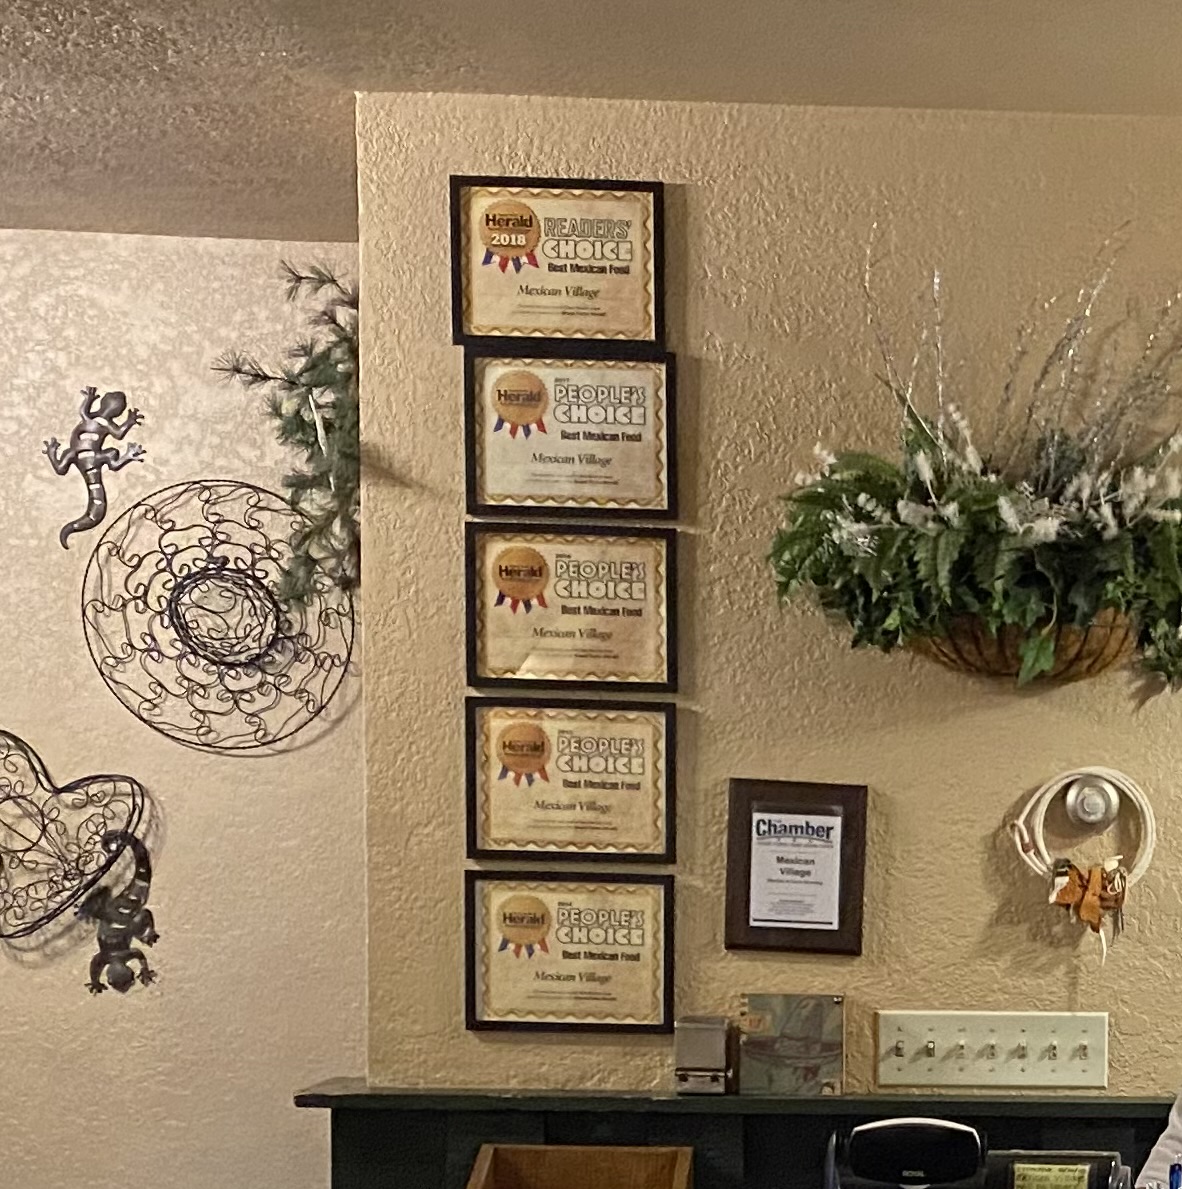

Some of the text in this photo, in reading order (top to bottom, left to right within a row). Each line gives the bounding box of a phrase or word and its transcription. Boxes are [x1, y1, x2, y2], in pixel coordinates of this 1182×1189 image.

[485, 213, 533, 228] Herald
[544, 217, 632, 239] READERS'
[491, 233, 527, 246] 2018
[542, 238, 633, 261] CHOICE
[548, 262, 630, 275] Best Mexican Food
[517, 284, 601, 300] Mexican Village
[554, 384, 646, 405] PEOPLE'S
[553, 404, 647, 426] CHOICE
[555, 560, 647, 581] PEOPLE'S
[554, 578, 647, 600] CHOICE
[556, 754, 645, 775] CHOICE
[755, 818, 835, 840] Chamber
[557, 908, 645, 927] PEOPLE'S
[556, 926, 644, 946] CHOICE
